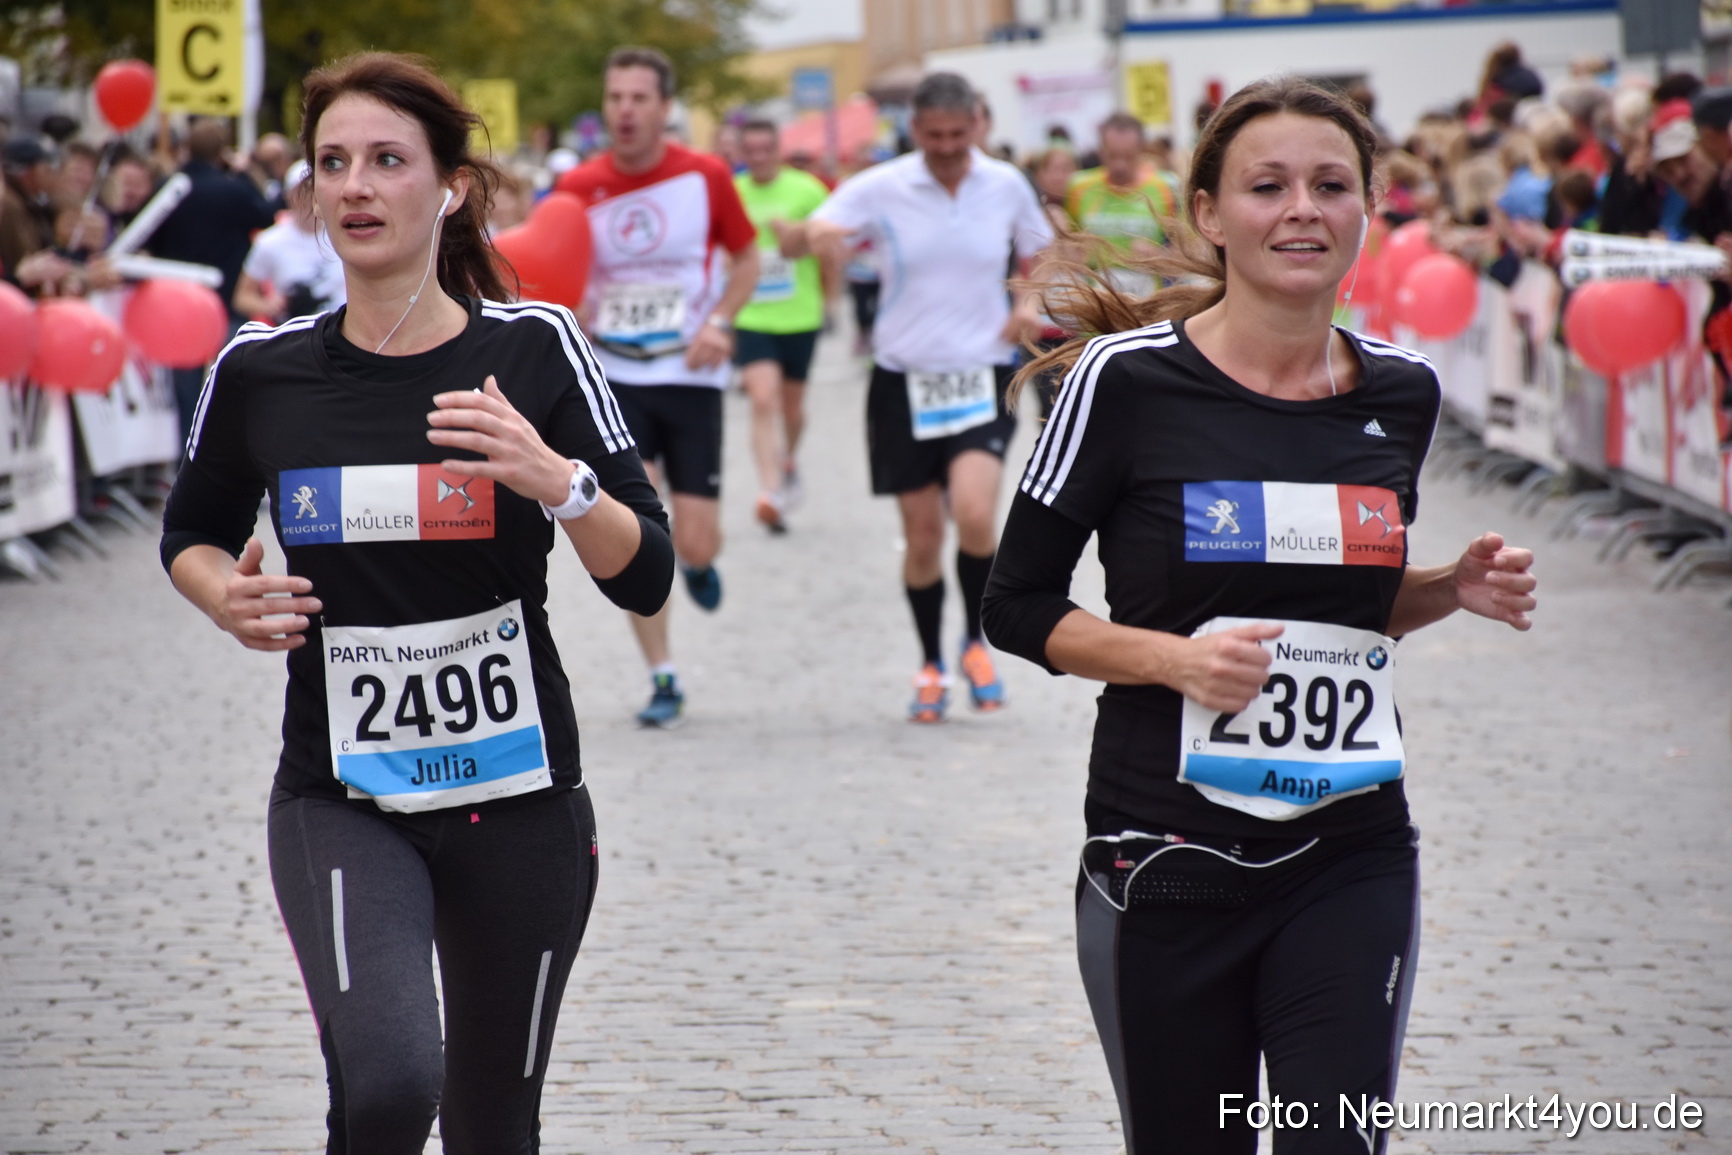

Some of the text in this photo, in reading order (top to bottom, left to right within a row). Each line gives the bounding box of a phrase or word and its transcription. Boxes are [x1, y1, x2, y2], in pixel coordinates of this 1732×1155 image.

[181, 24, 221, 84] C
[283, 523, 338, 535] PEUGEOT
[1189, 540, 1263, 550] PEUGEOT
[330, 629, 491, 664] PARTL Neumarkt
[1276, 642, 1360, 667] Neumarkt
[351, 653, 518, 742] 2496
[341, 739, 350, 752] C
[411, 753, 477, 786] Julia
[1259, 769, 1332, 800] Anne
